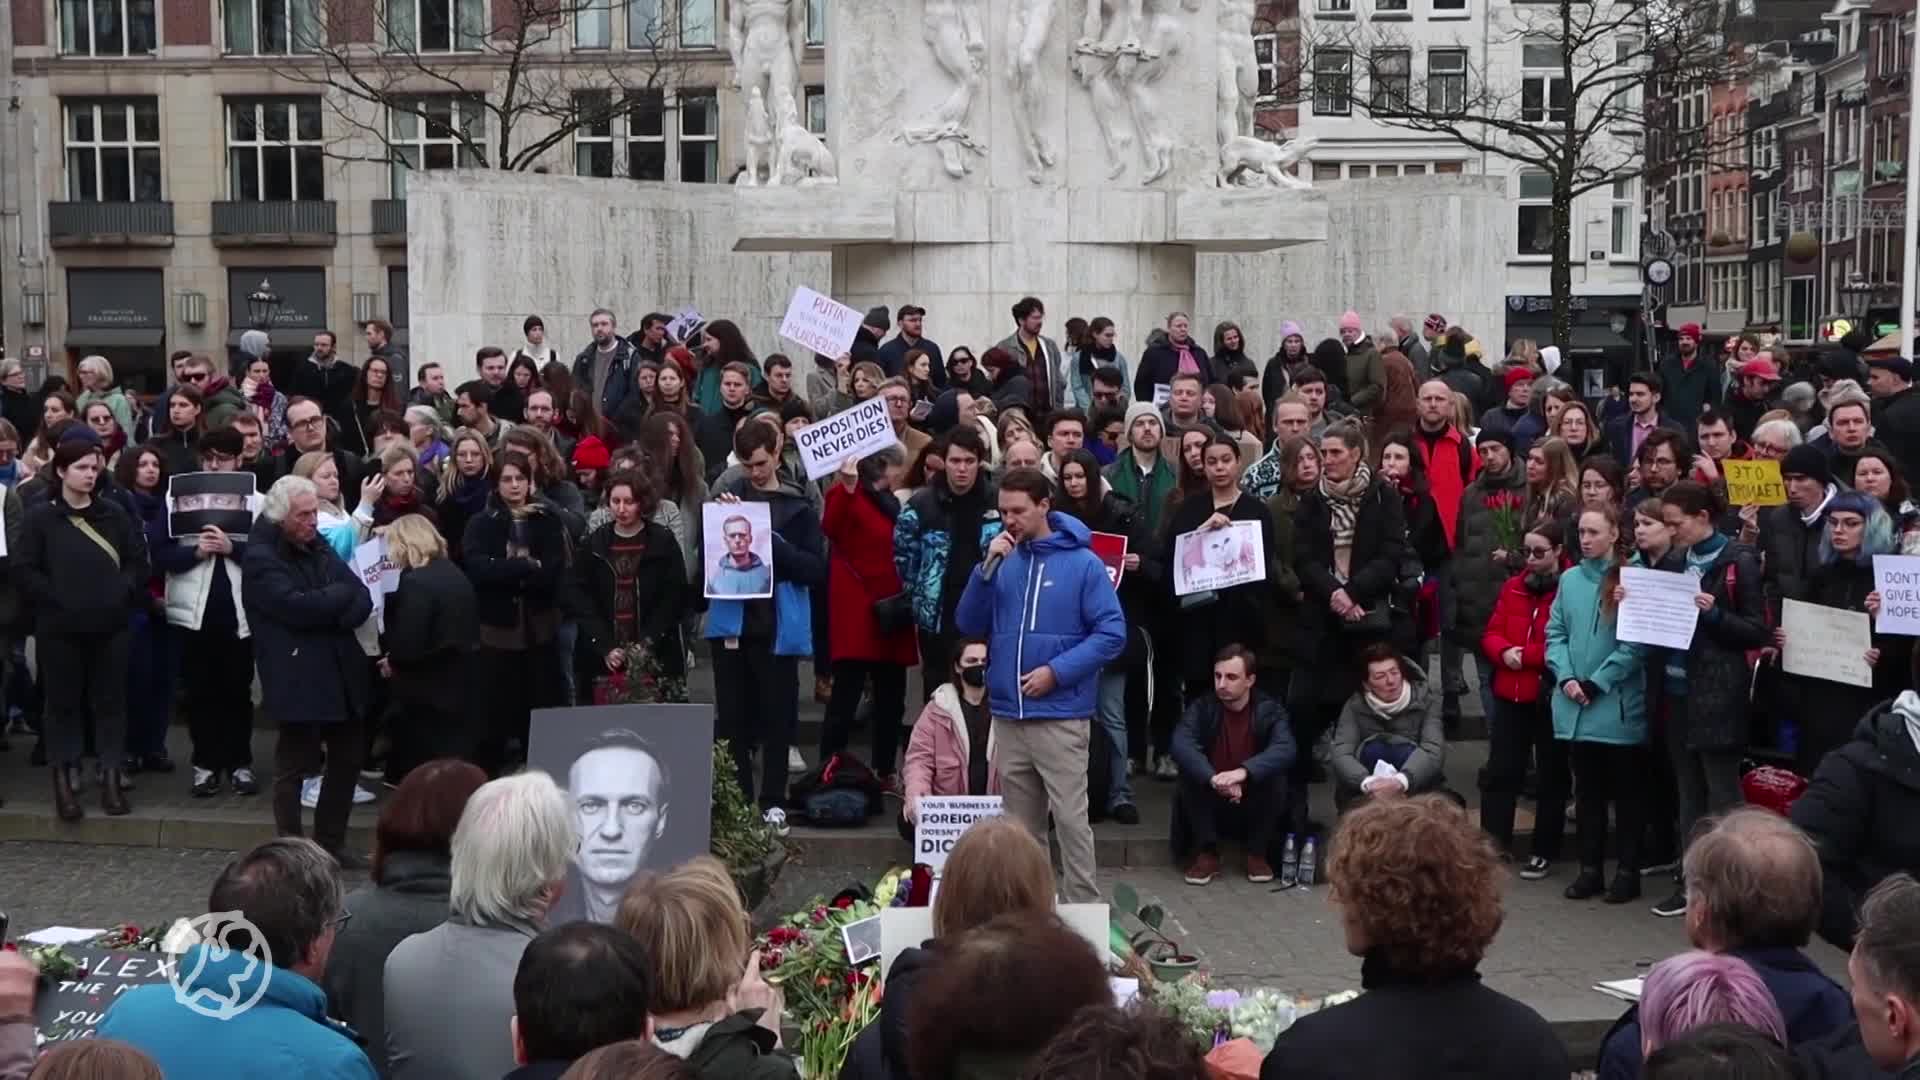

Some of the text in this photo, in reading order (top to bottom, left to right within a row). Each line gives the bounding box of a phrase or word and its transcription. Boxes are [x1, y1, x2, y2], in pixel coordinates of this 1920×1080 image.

[813, 297, 848, 324] PUTIN
[800, 400, 884, 448] OPPOSITION
[811, 431, 857, 461] NEVER
[856, 415, 890, 442] DIES!
[1733, 465, 1765, 481] ЭТО
[1885, 588, 1913, 602] GIVE
[1886, 605, 1920, 620] HOPE
[920, 801, 946, 810] YOUR
[921, 828, 961, 836] DOESN'T
[58, 980, 105, 995] THE
